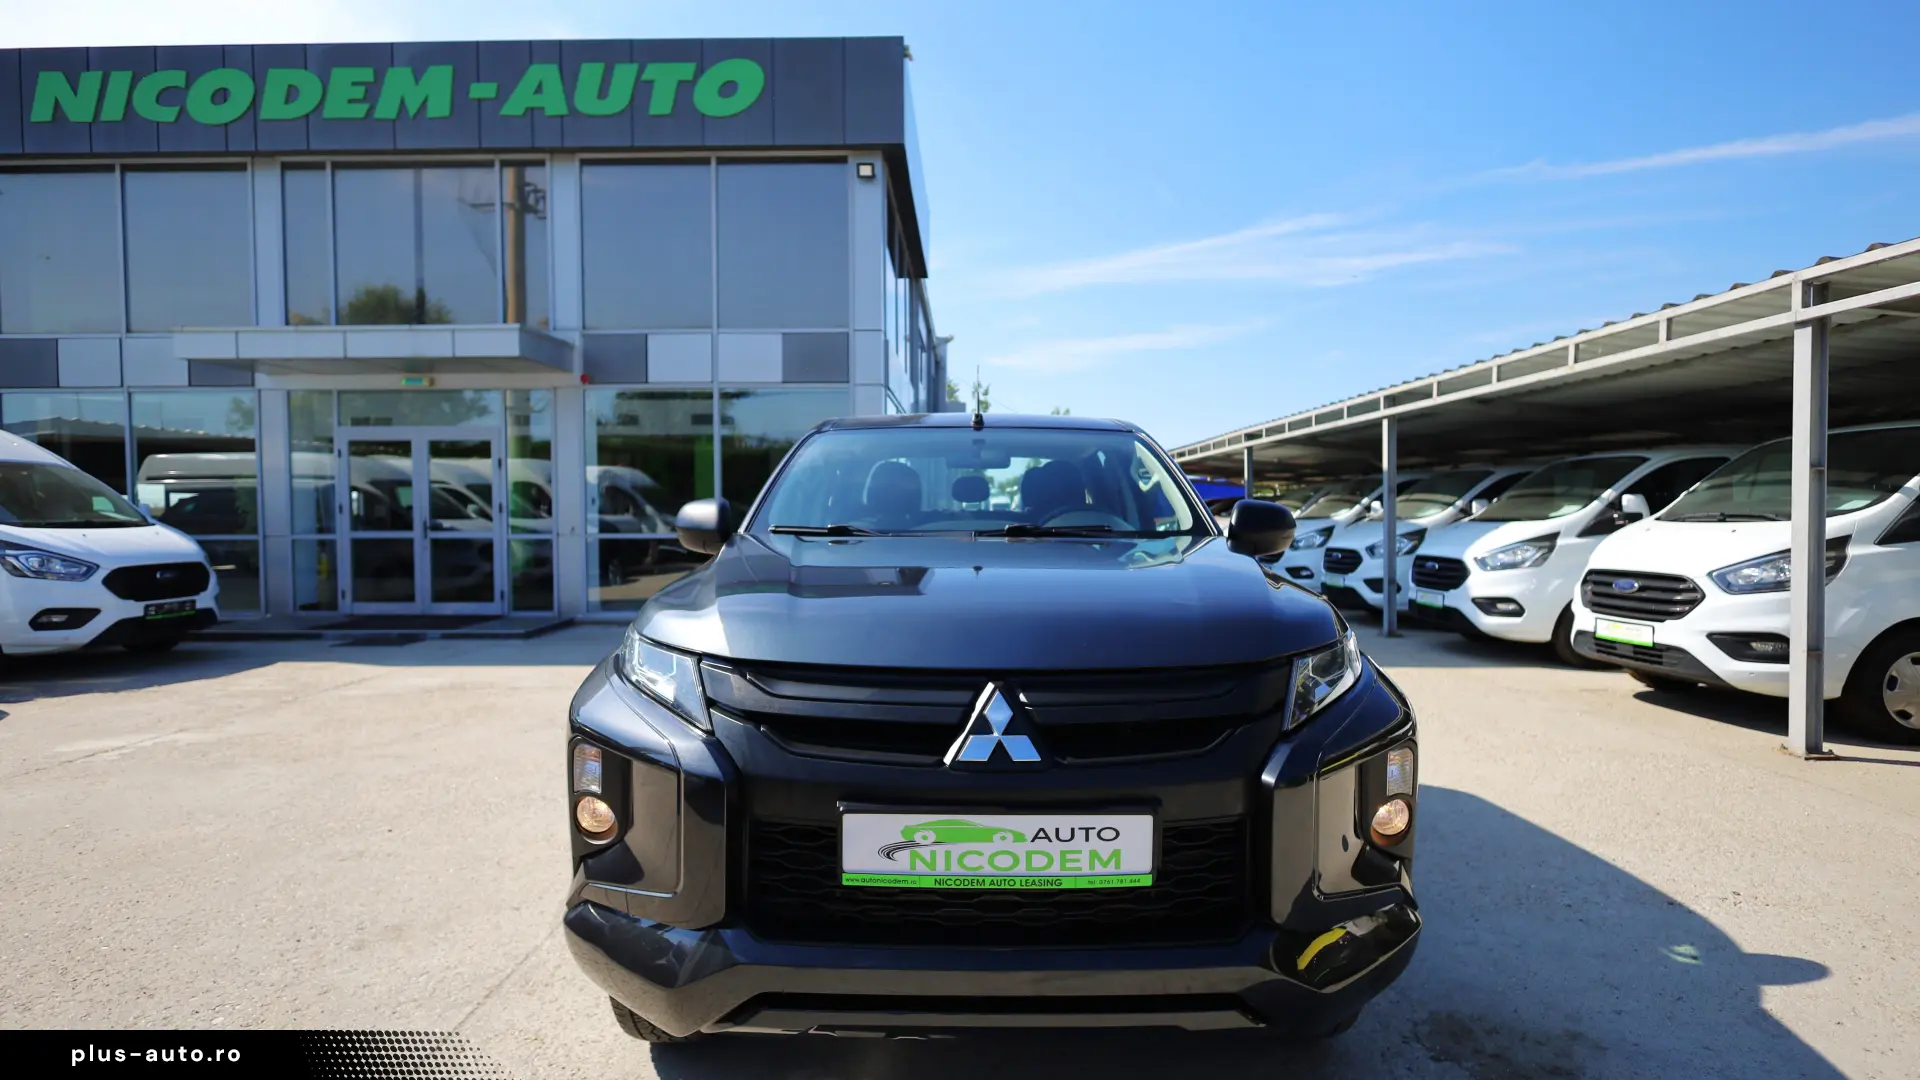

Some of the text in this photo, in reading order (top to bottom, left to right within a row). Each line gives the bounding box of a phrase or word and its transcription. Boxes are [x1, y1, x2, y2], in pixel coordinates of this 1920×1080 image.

[1030, 826, 1121, 843] AUTO
[909, 848, 1122, 872] NICODEM
[845, 877, 917, 885] www.autonicodem.ro
[934, 878, 1063, 887] NICODEM AUTO LEASING
